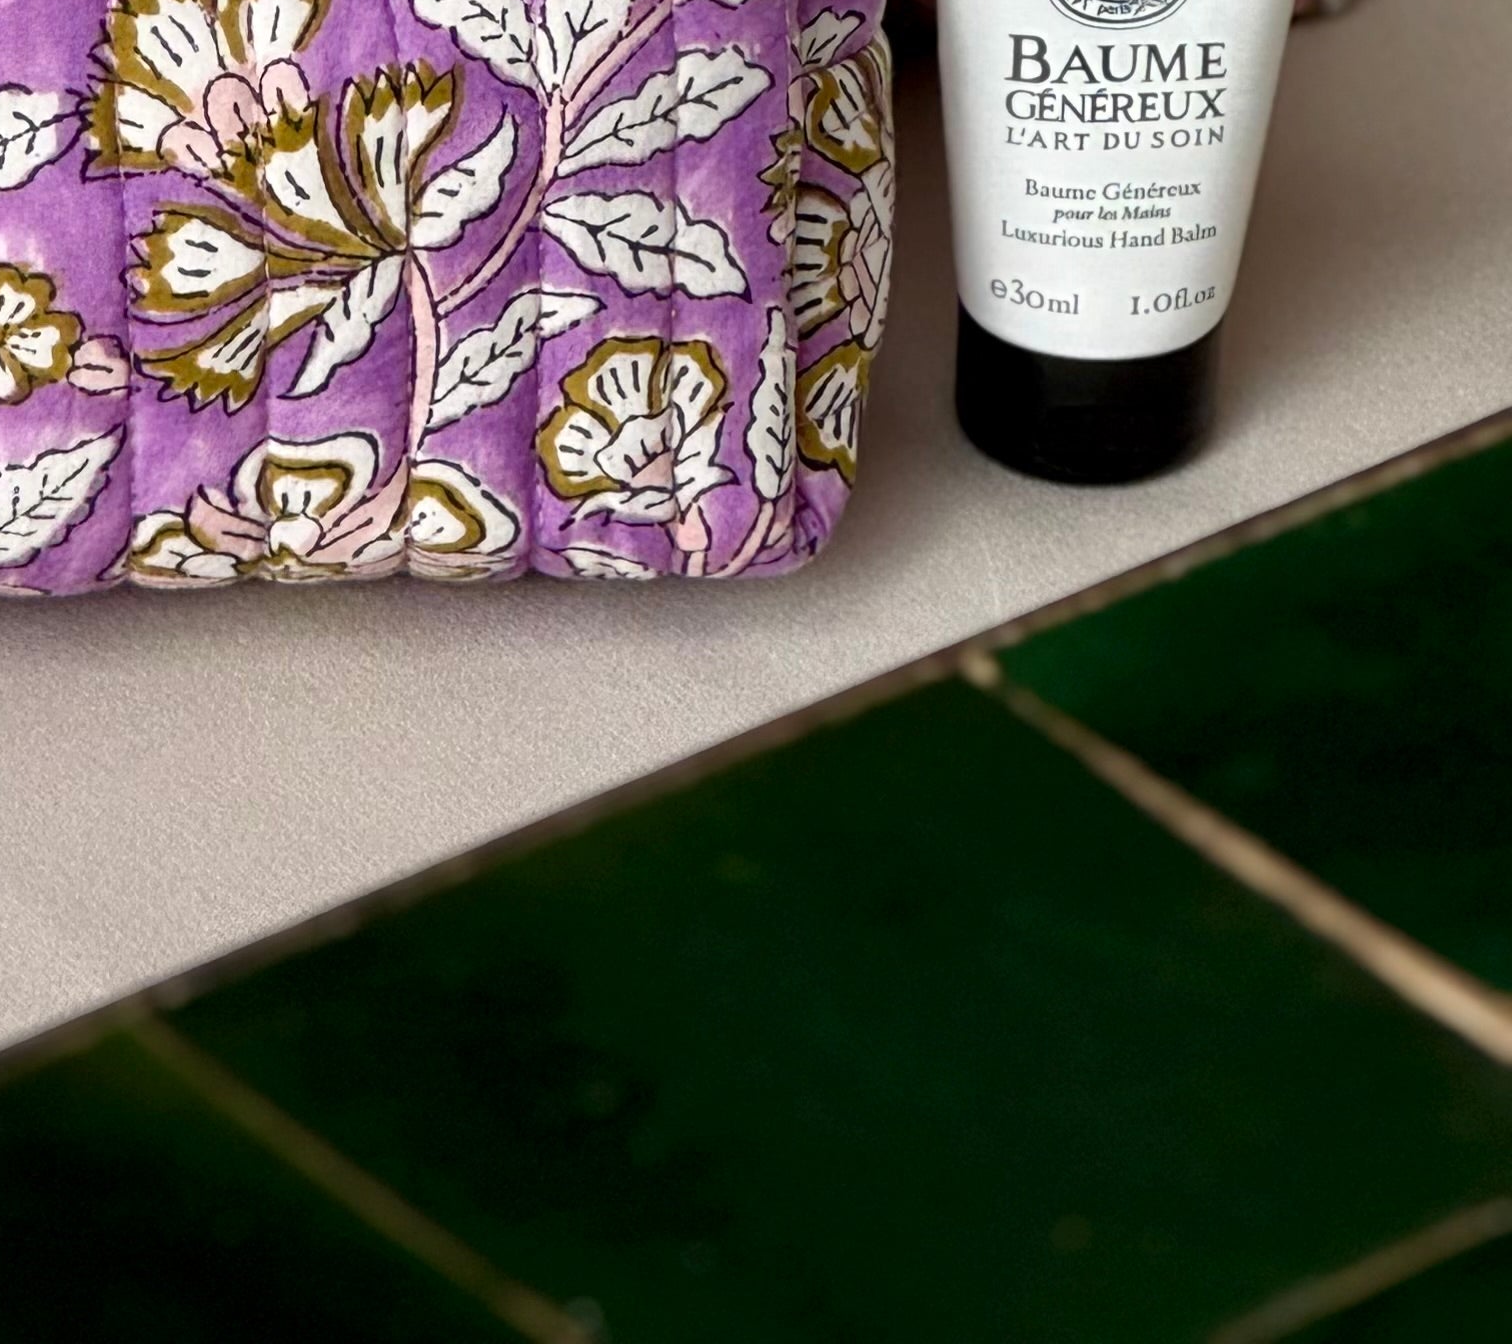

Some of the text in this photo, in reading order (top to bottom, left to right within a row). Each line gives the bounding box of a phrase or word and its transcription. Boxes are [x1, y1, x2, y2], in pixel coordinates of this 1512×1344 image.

[1004, 33, 1228, 84] BAUME
[1005, 87, 1227, 123] GÉNÉREUX
[1005, 125, 1225, 151] L'ART DU SOIN
[1024, 178, 1202, 201] Baume Généreux
[1052, 204, 1172, 223] pour les Mains
[1001, 219, 1217, 248] Luxurious Hand Balm
